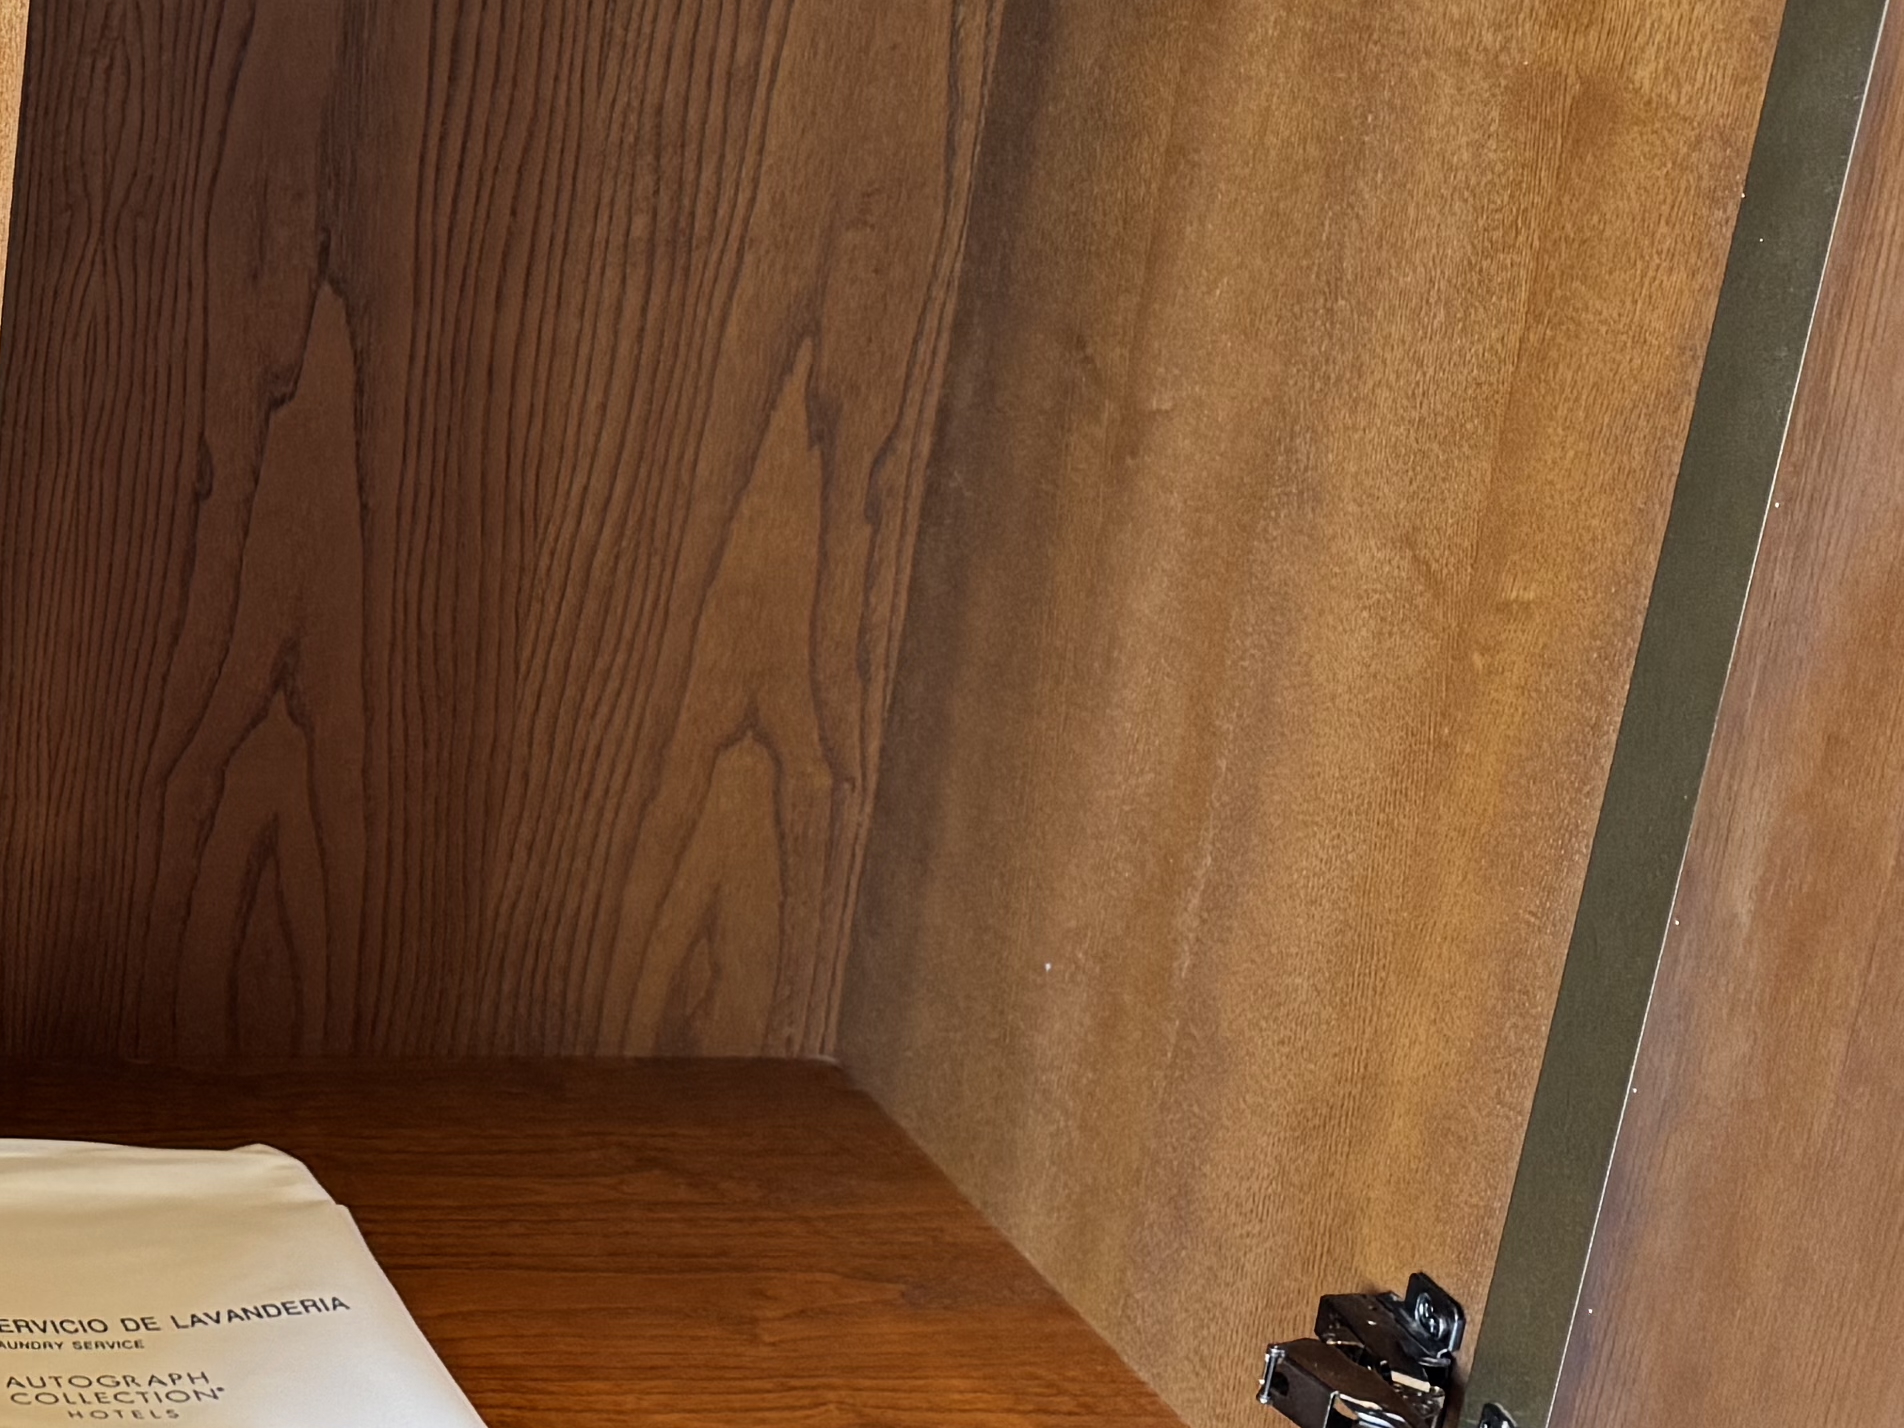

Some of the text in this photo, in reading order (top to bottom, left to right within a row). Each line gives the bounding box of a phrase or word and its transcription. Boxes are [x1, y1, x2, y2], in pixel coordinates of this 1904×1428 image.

[120, 1316, 162, 1332] DE
[170, 1296, 350, 1330] LAVANDERIA
[72, 1339, 145, 1350] SERVICE
[6, 1371, 210, 1389] AUTOGRAPH
[68, 1409, 180, 1420] HOTELS
